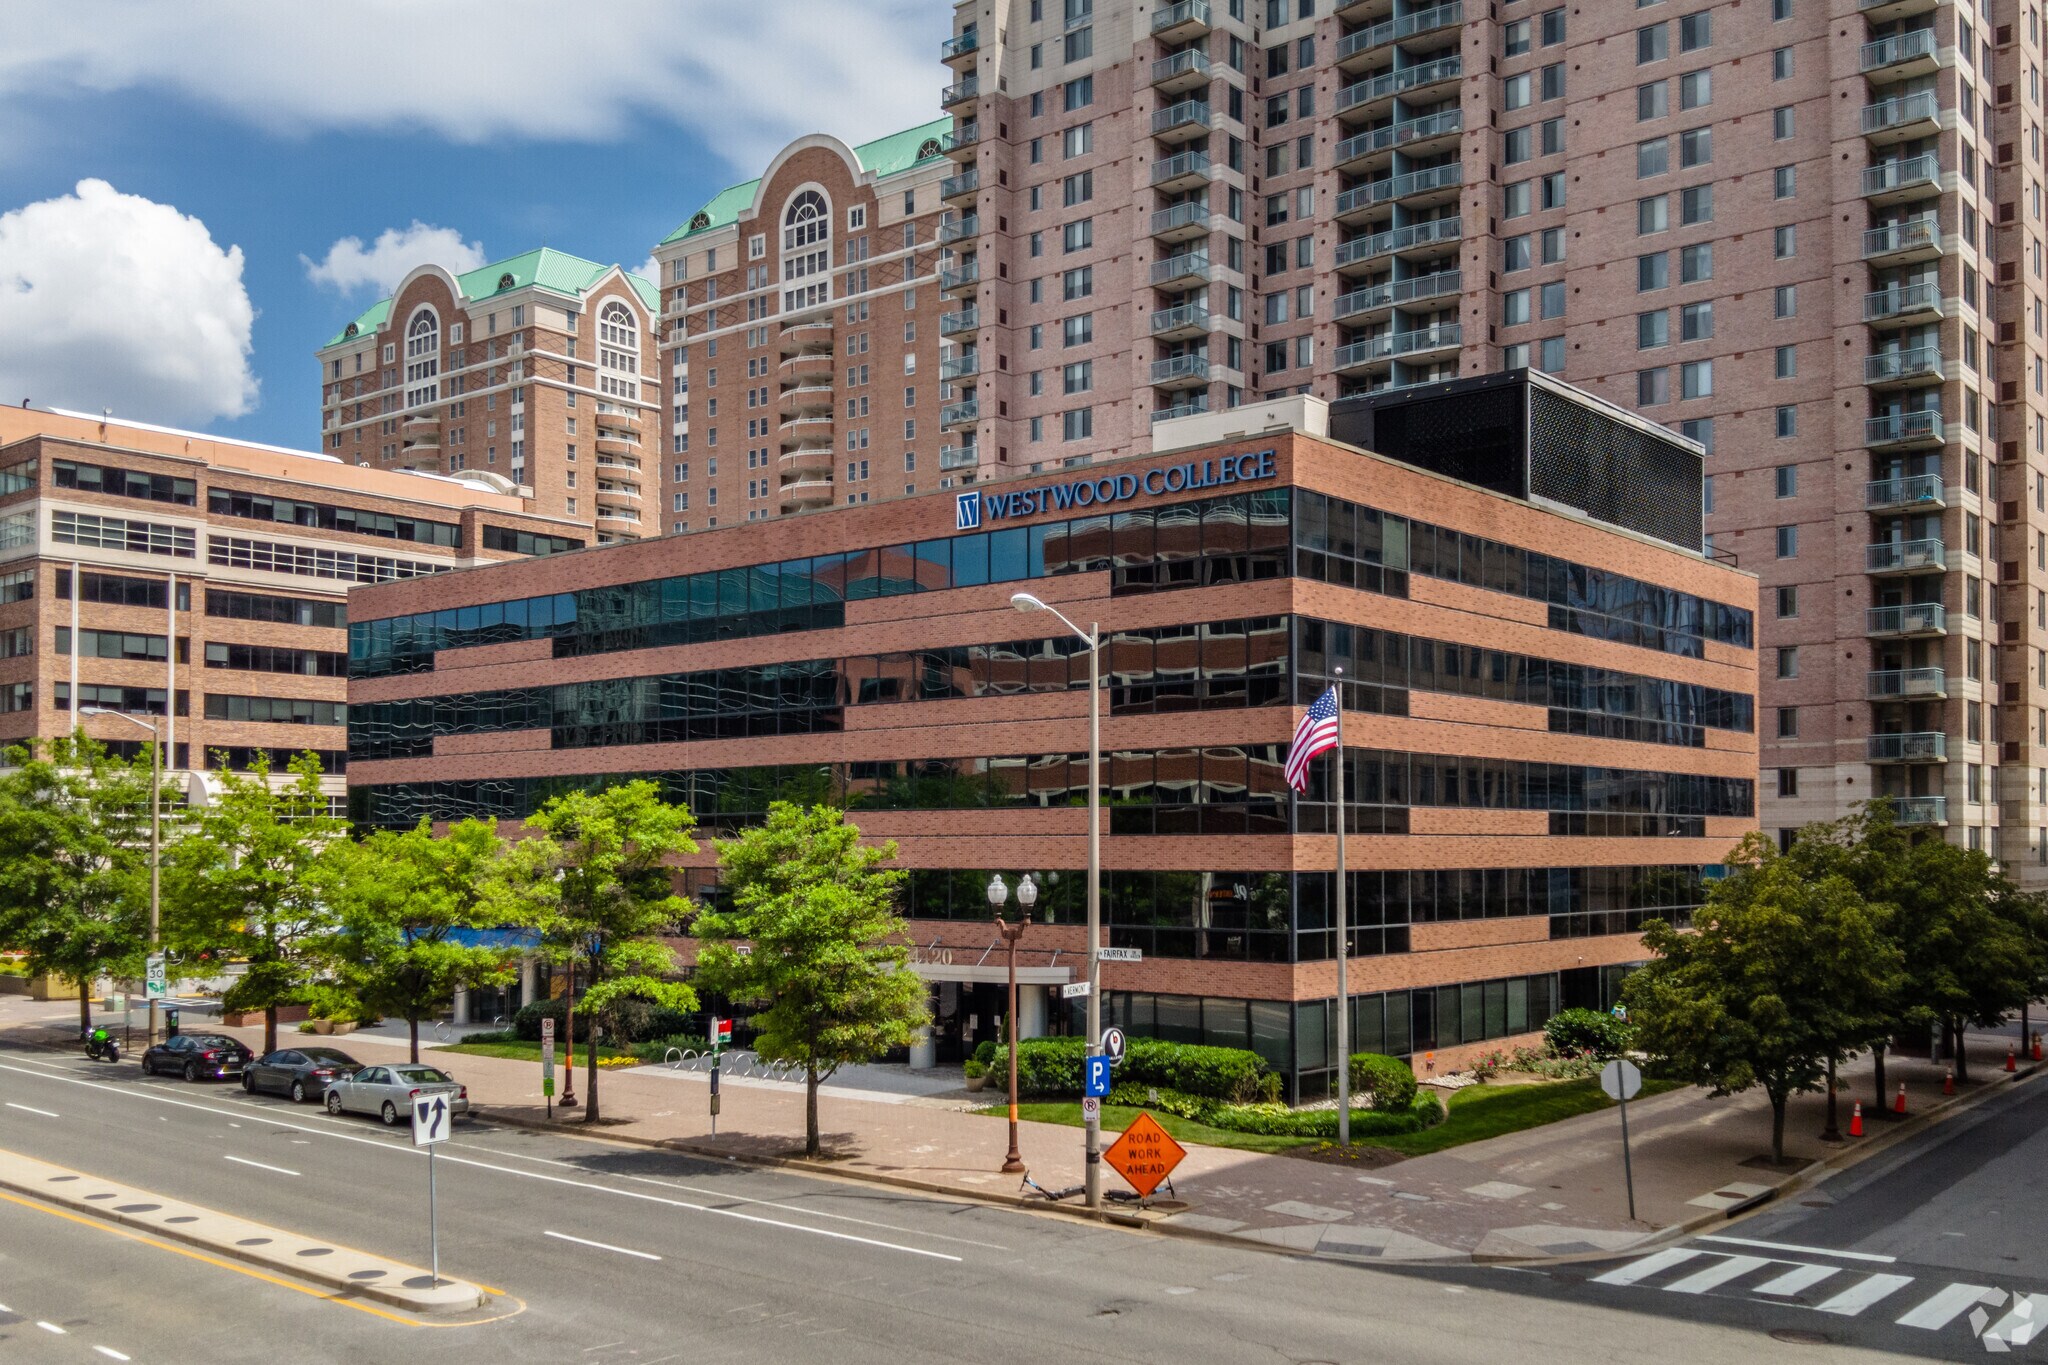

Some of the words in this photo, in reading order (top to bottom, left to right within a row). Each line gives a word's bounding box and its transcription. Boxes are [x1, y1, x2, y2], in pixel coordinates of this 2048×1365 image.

[984, 473, 1138, 520] WESTWOOD
[1143, 449, 1276, 495] COLLEGE
[1103, 949, 1128, 959] FAIRFAX
[149, 969, 163, 978] 30
[1067, 984, 1086, 995] VERMONT
[1092, 1061, 1103, 1085] P
[1128, 1132, 1161, 1144] ROAD
[1128, 1148, 1161, 1159] WORK
[1126, 1163, 1165, 1175] AHEAD
